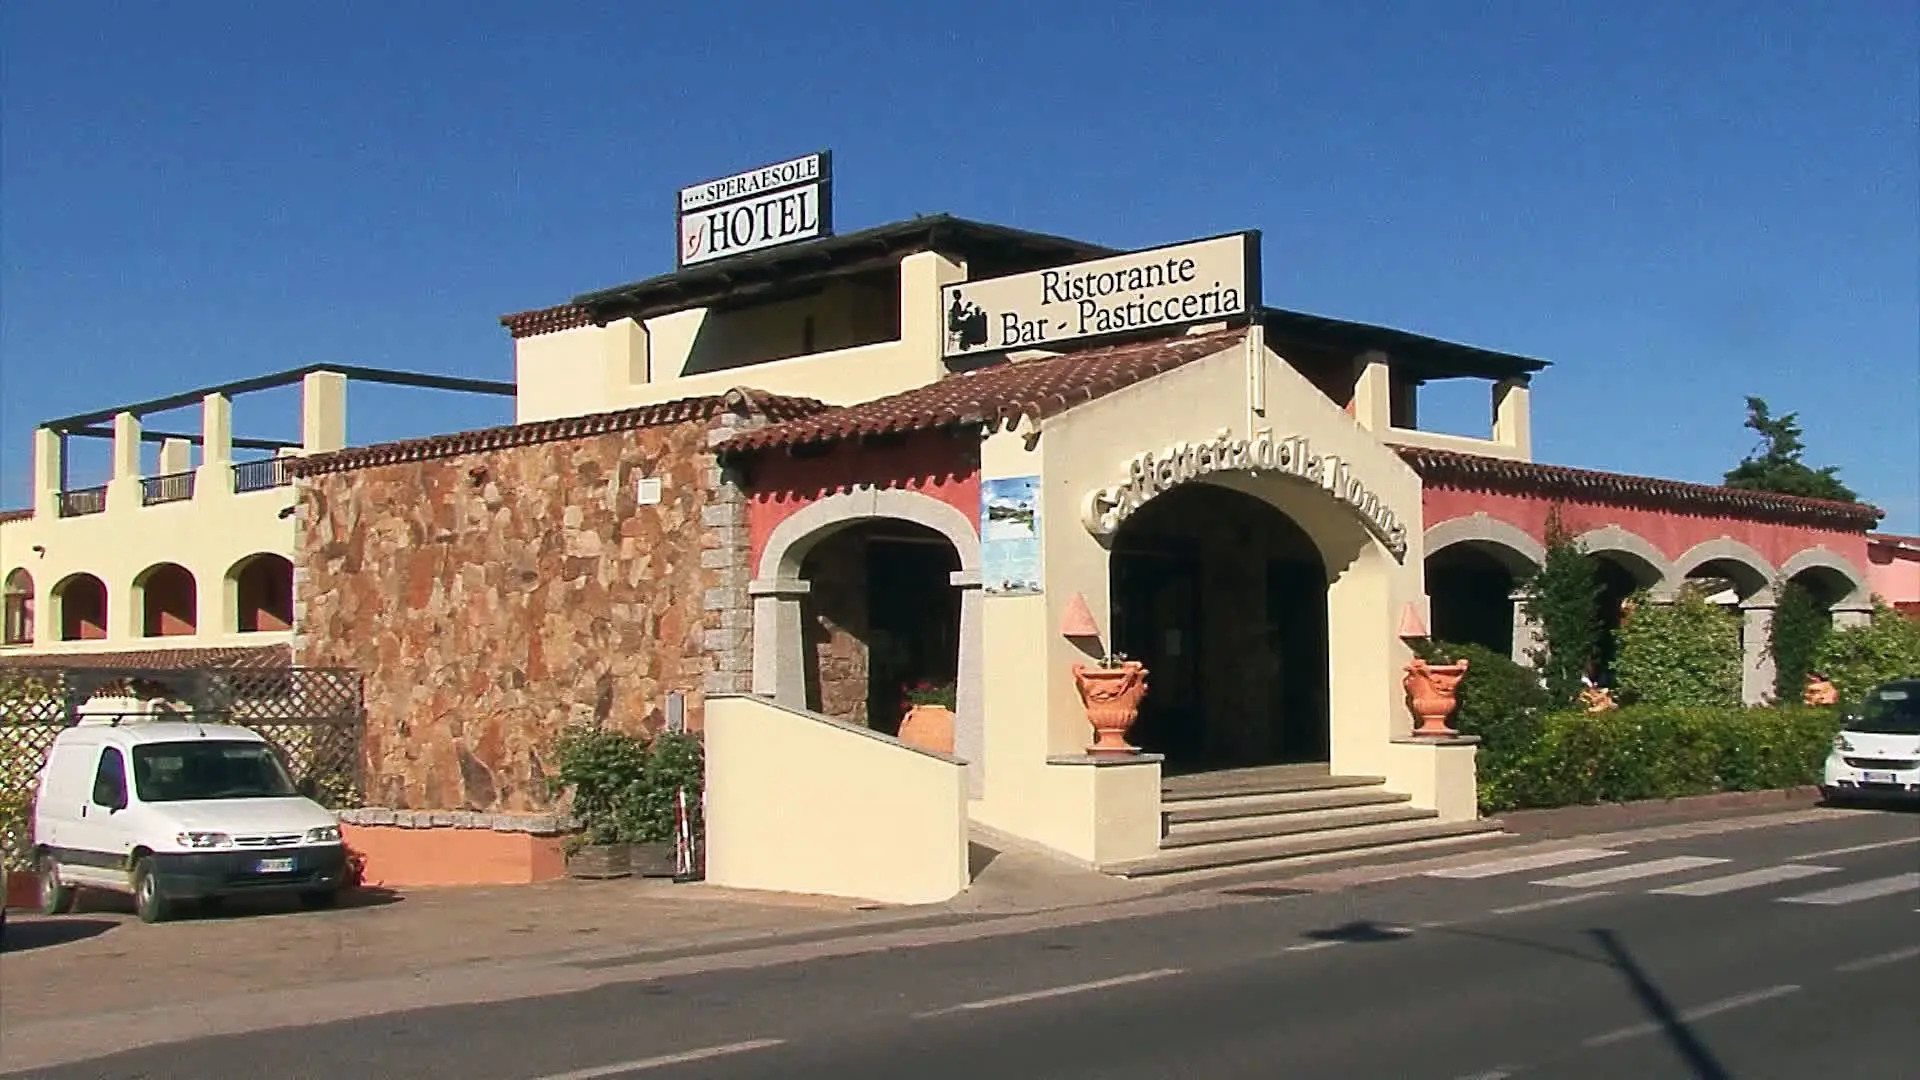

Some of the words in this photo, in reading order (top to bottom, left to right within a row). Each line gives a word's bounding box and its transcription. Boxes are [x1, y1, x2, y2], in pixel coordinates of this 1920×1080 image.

[706, 158, 817, 202] SPERAESOLE
[707, 192, 817, 254] HOTEL
[1041, 257, 1196, 306] Ristorante
[1001, 312, 1048, 346] Bar
[1078, 282, 1241, 334] Pasticceria
[1081, 427, 1252, 532] Caffetteria
[1251, 427, 1325, 482] della
[1322, 455, 1408, 553] Nonna
